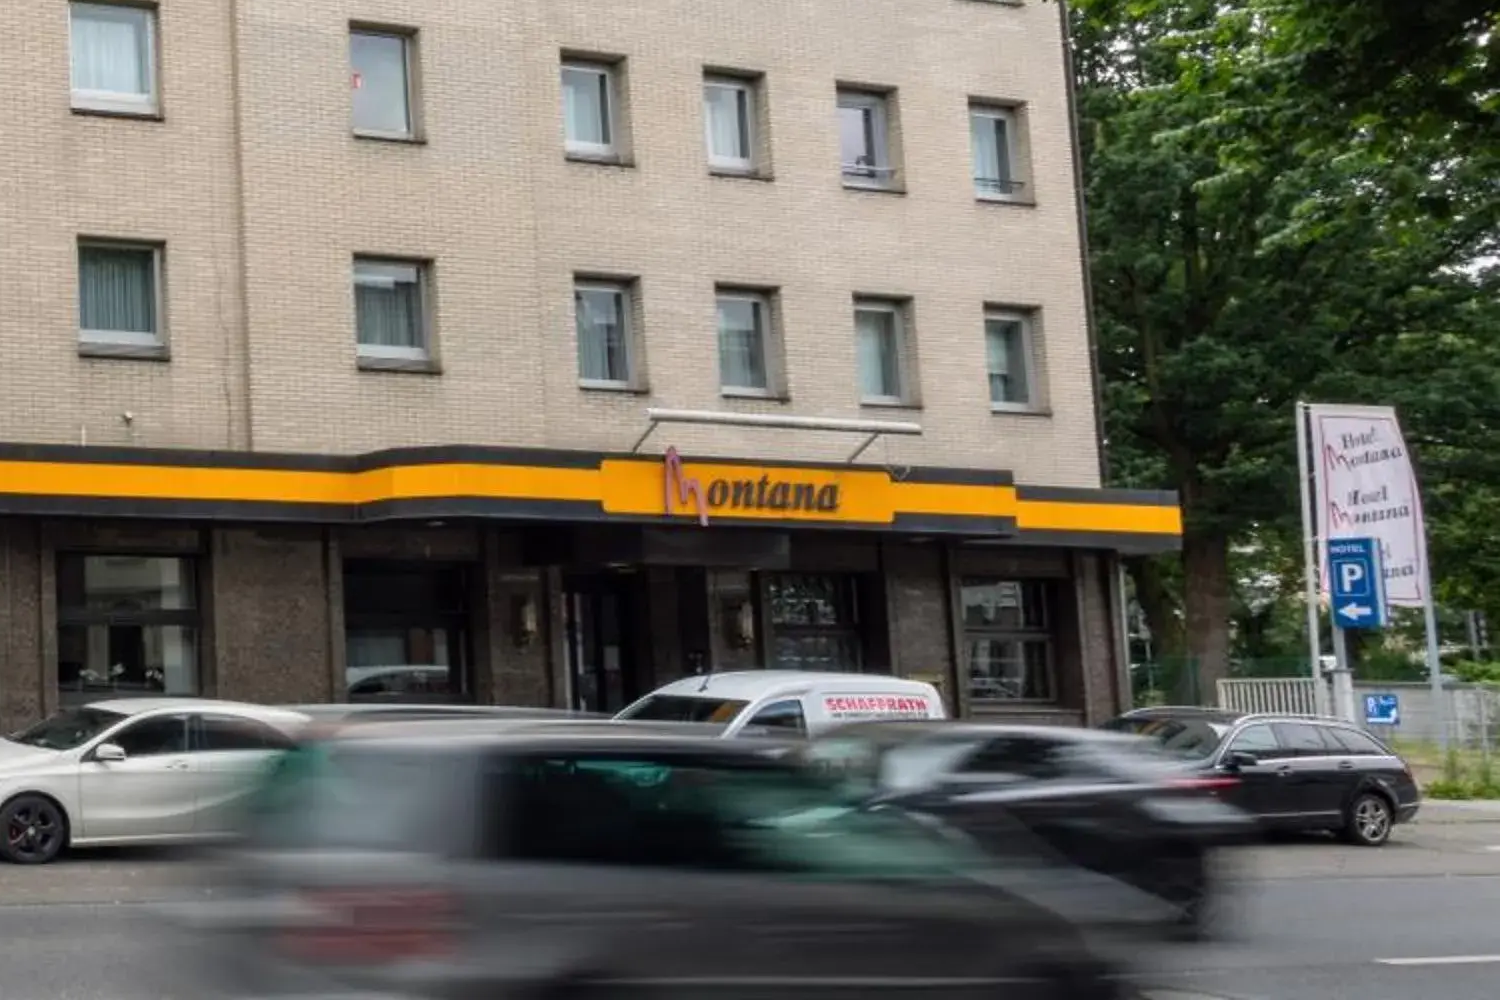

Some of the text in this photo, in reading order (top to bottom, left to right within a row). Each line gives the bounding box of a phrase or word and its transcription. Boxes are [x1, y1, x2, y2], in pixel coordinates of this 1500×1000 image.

[664, 446, 840, 527] Montana
[1330, 544, 1366, 554] HOTEL
[1341, 563, 1363, 592] P
